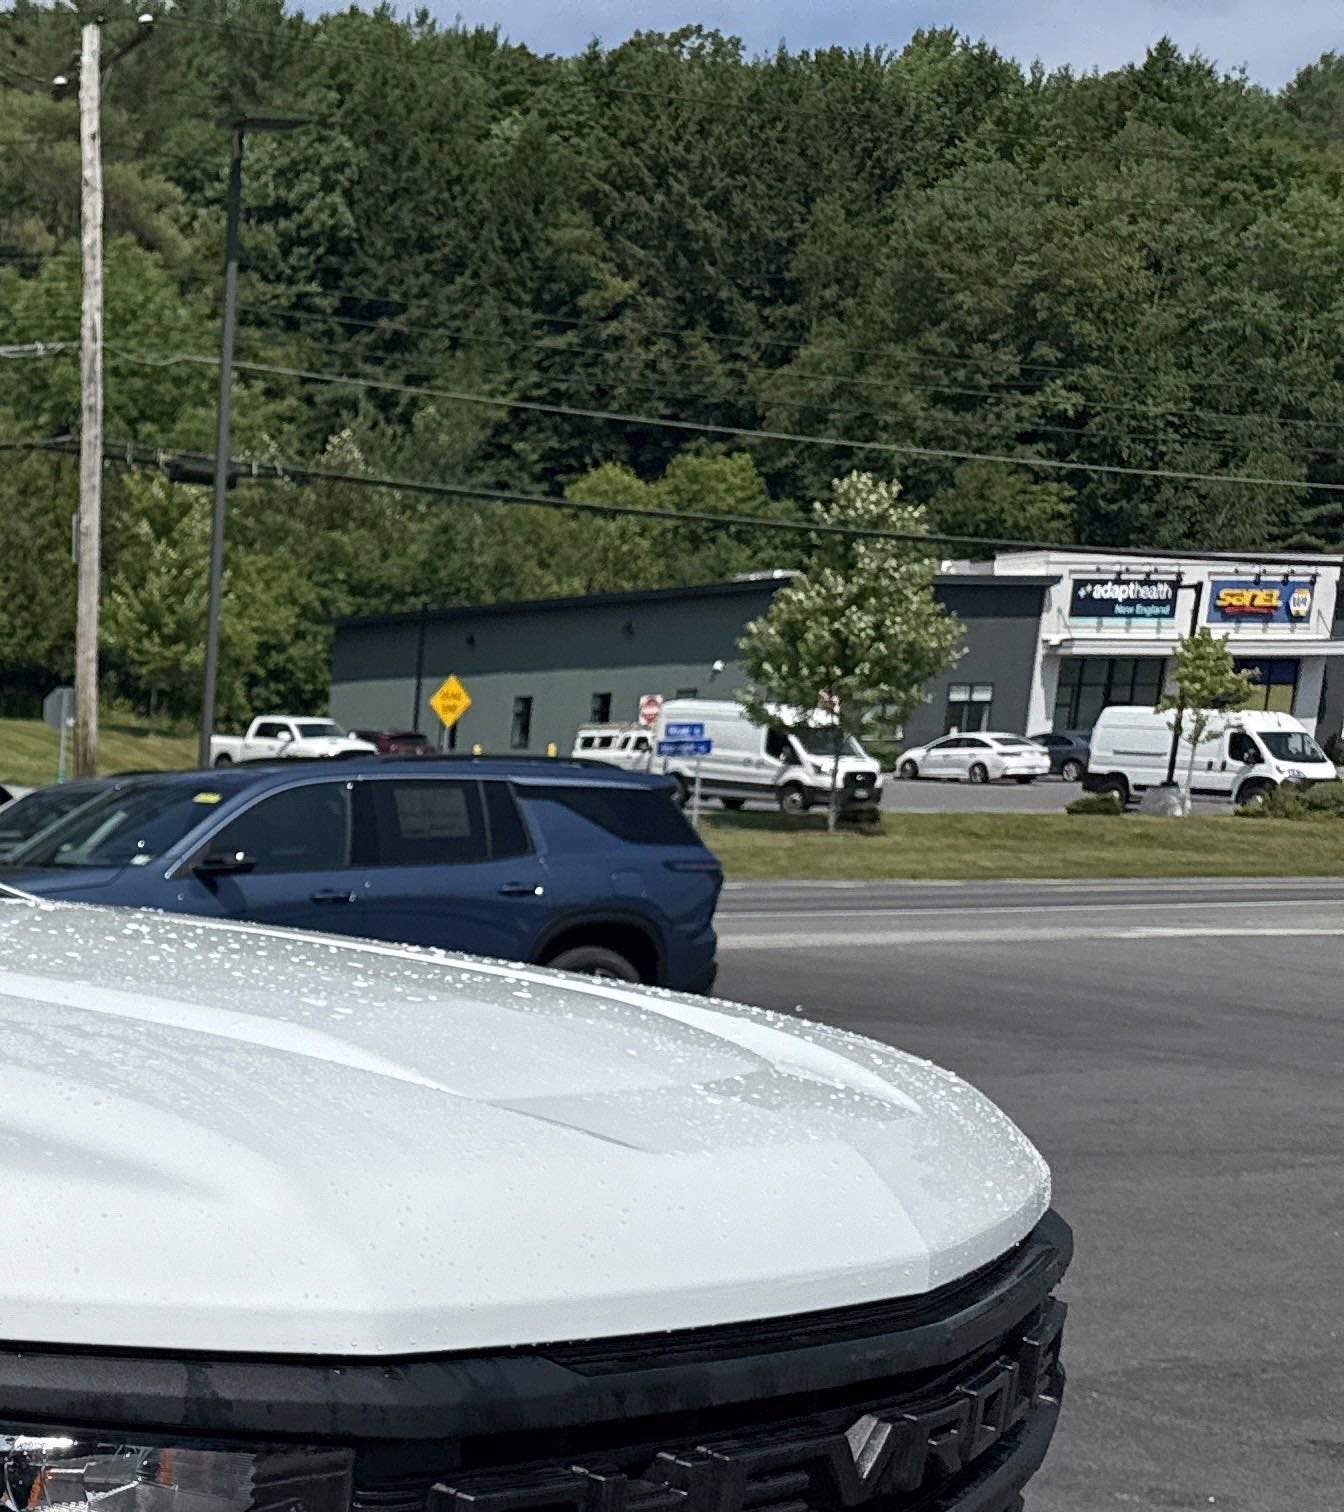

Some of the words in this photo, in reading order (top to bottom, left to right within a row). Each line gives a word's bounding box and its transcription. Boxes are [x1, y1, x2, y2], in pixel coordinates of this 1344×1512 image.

[1092, 581, 1172, 602] adapthealth
[1114, 604, 1134, 615] New
[1135, 603, 1170, 616] England
